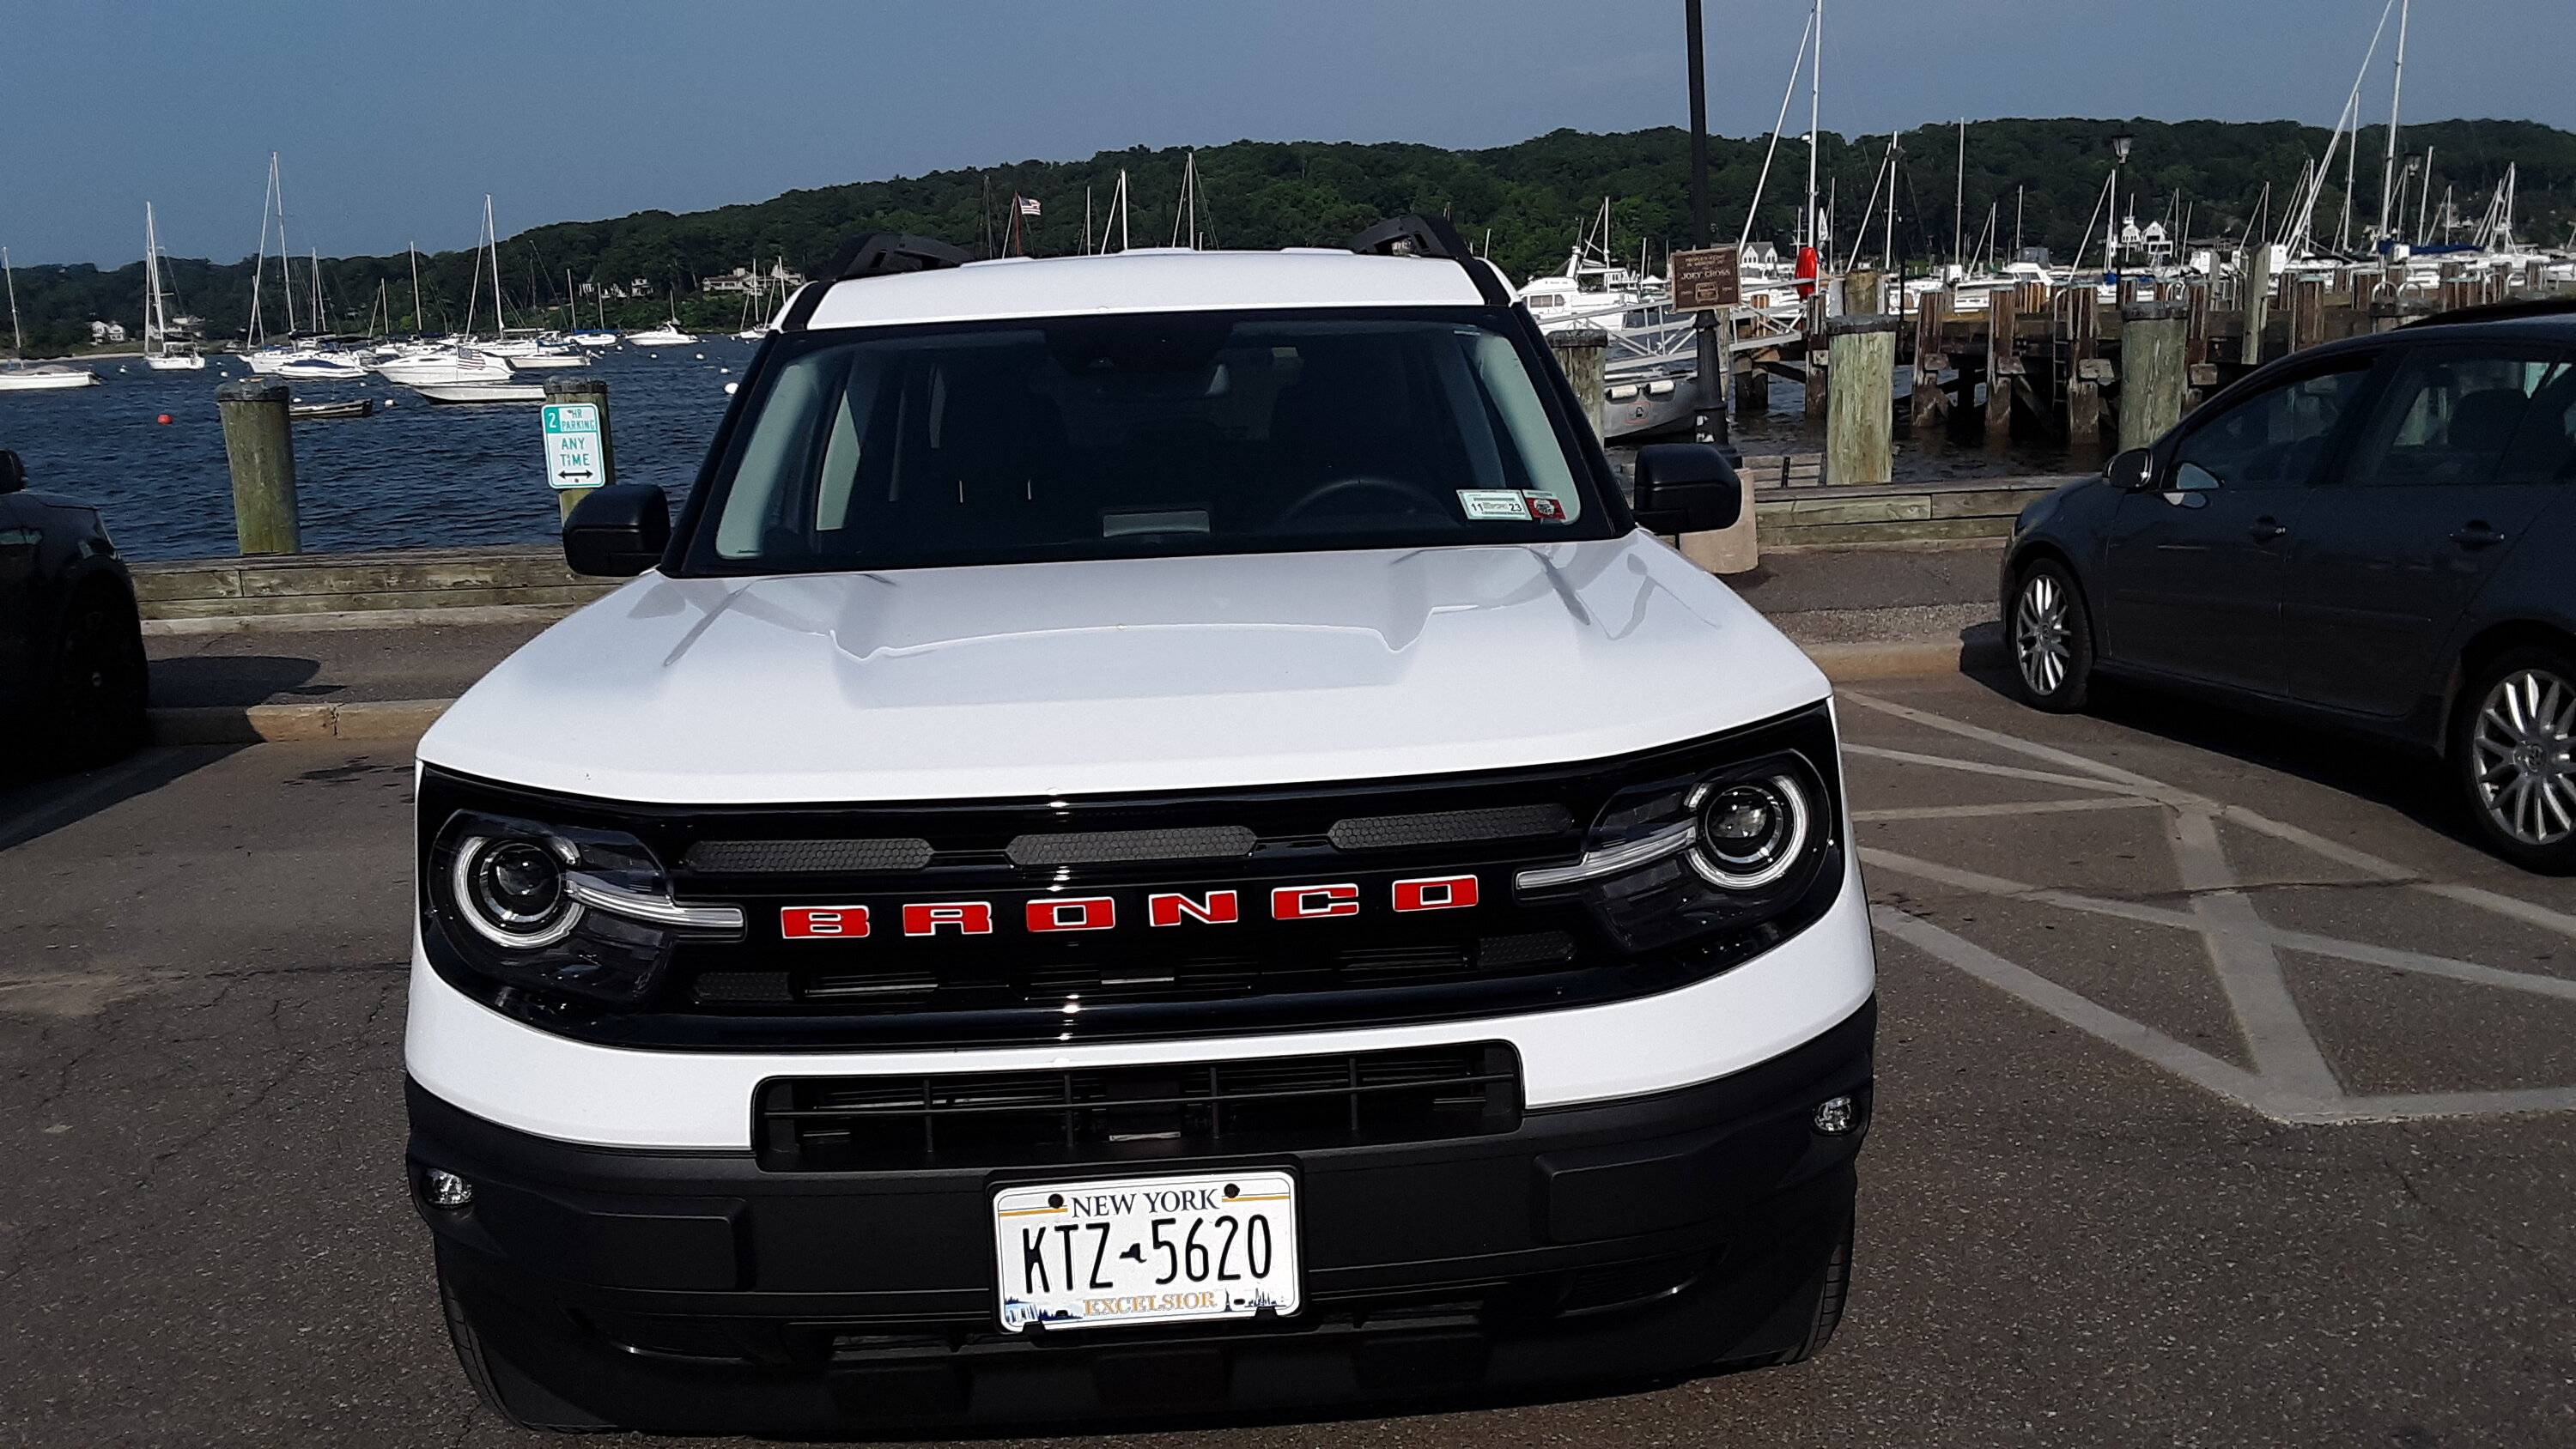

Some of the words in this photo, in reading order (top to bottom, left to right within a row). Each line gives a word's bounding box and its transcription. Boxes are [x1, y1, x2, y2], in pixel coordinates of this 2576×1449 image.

[548, 412, 557, 428] 2
[572, 408, 583, 419] HR
[562, 419, 595, 430] PARKING
[562, 437, 586, 451] ANY
[560, 453, 591, 467] TIME
[1509, 503, 1522, 512] 23
[780, 874, 1479, 939] BRONCO
[1071, 1193, 1137, 1218] NEW
[1142, 1188, 1220, 1213] YORK
[1083, 1291, 1218, 1318] EXCELSIOR
